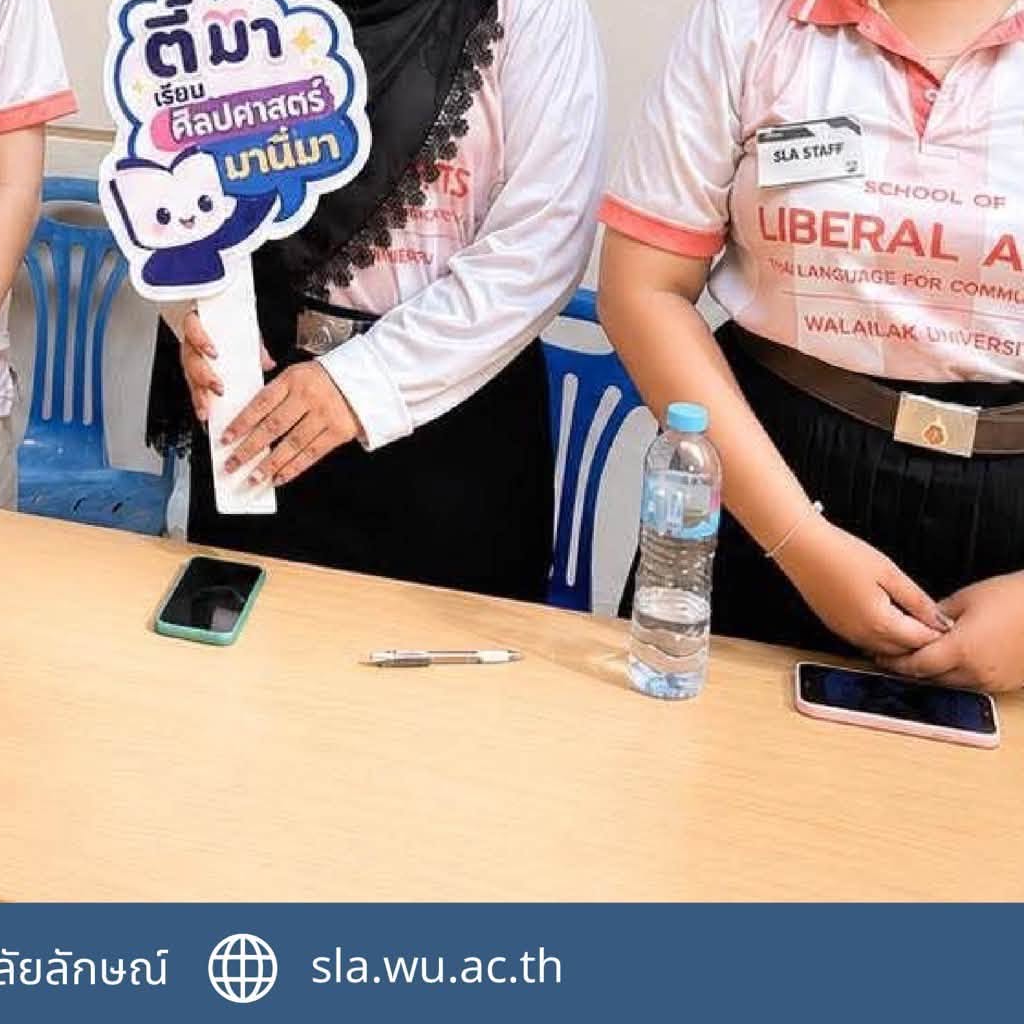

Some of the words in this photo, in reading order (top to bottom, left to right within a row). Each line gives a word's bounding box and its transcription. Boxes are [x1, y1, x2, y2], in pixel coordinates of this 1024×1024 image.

[172, 77, 326, 141] ศิลปศาสตร์
[772, 147, 800, 163] SLA
[801, 141, 845, 160] STAFF
[864, 180, 963, 205] SCHOOL
[973, 193, 1008, 210] OF
[757, 205, 960, 263] LIBERAL
[795, 262, 896, 286] LANGUAGE
[902, 273, 943, 292] FOR
[803, 314, 918, 343] WALAILAK
